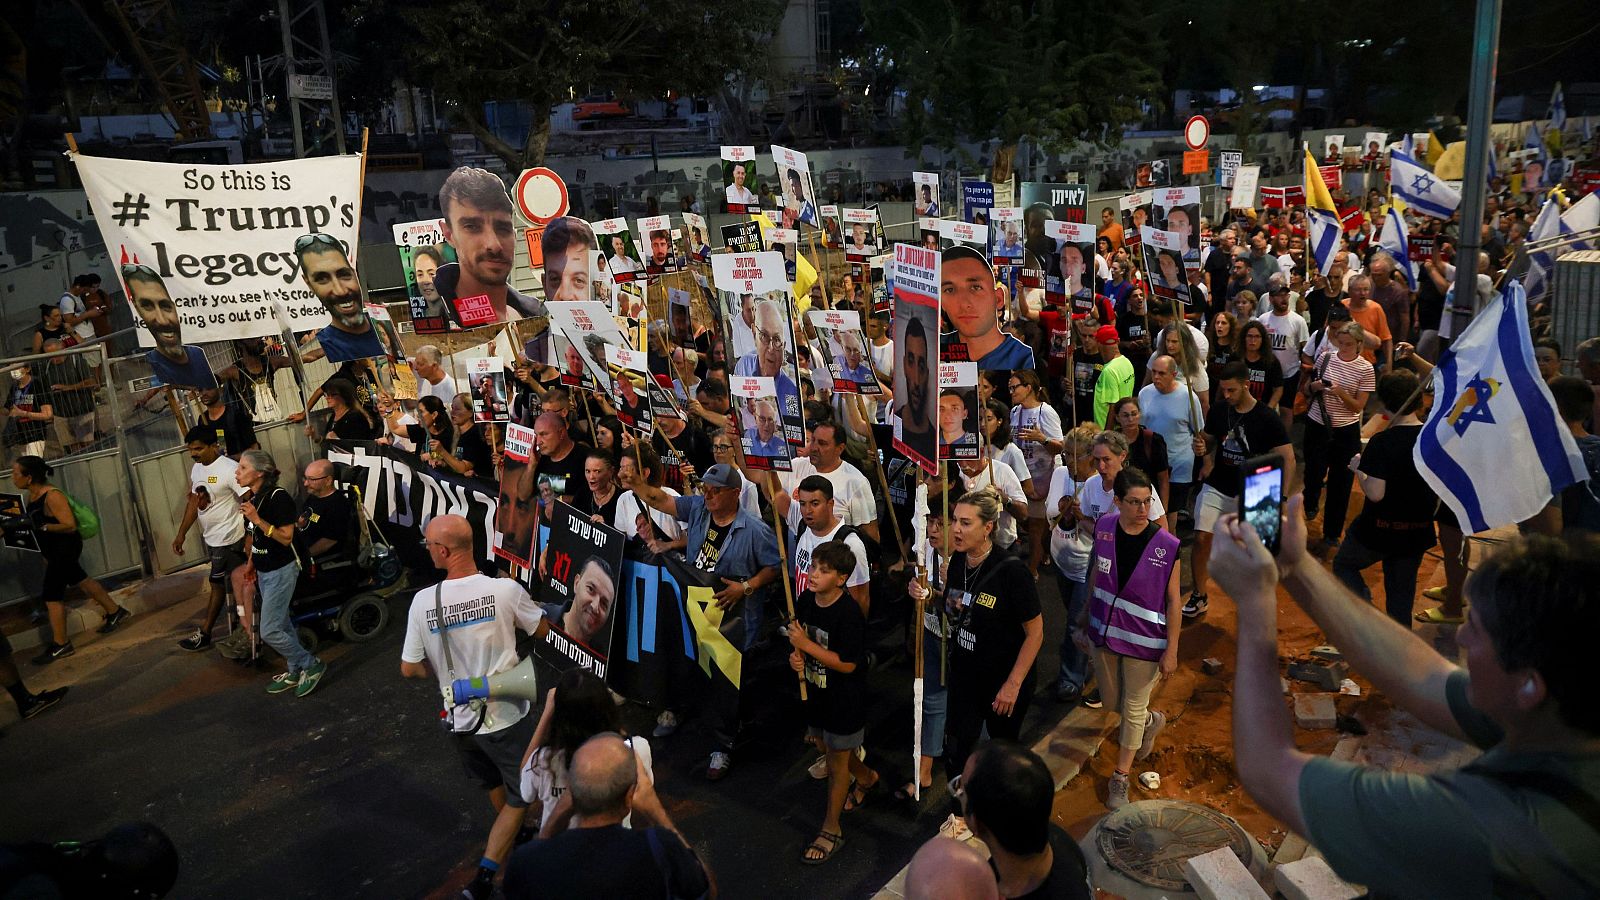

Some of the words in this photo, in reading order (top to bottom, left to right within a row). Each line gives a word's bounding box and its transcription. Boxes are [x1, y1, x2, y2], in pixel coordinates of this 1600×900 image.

[183, 169, 215, 190] So
[220, 170, 265, 190] this
[272, 171, 291, 190] is
[1051, 187, 1085, 207] לאיתן
[112, 193, 150, 227] #
[165, 196, 354, 234] Trump's
[529, 232, 542, 242] ותר
[896, 245, 903, 262] 22
[175, 291, 208, 308] can't
[211, 294, 236, 309] you
[240, 293, 262, 303] see
[263, 288, 290, 302] h's
[464, 295, 488, 310] עדיין
[209, 312, 225, 324] us
[228, 311, 251, 323] out
[254, 308, 268, 320] of
[465, 307, 493, 321] בעזה.
[508, 428, 516, 439] 22
[568, 514, 591, 541] שרעבי
[592, 529, 607, 548] יוסי
[553, 550, 572, 584] לא
[449, 599, 480, 615] המשפחות
[481, 595, 495, 607] מטה
[462, 605, 496, 624] החטופים
[569, 644, 593, 672] שכולם
[594, 660, 605, 679] עד
